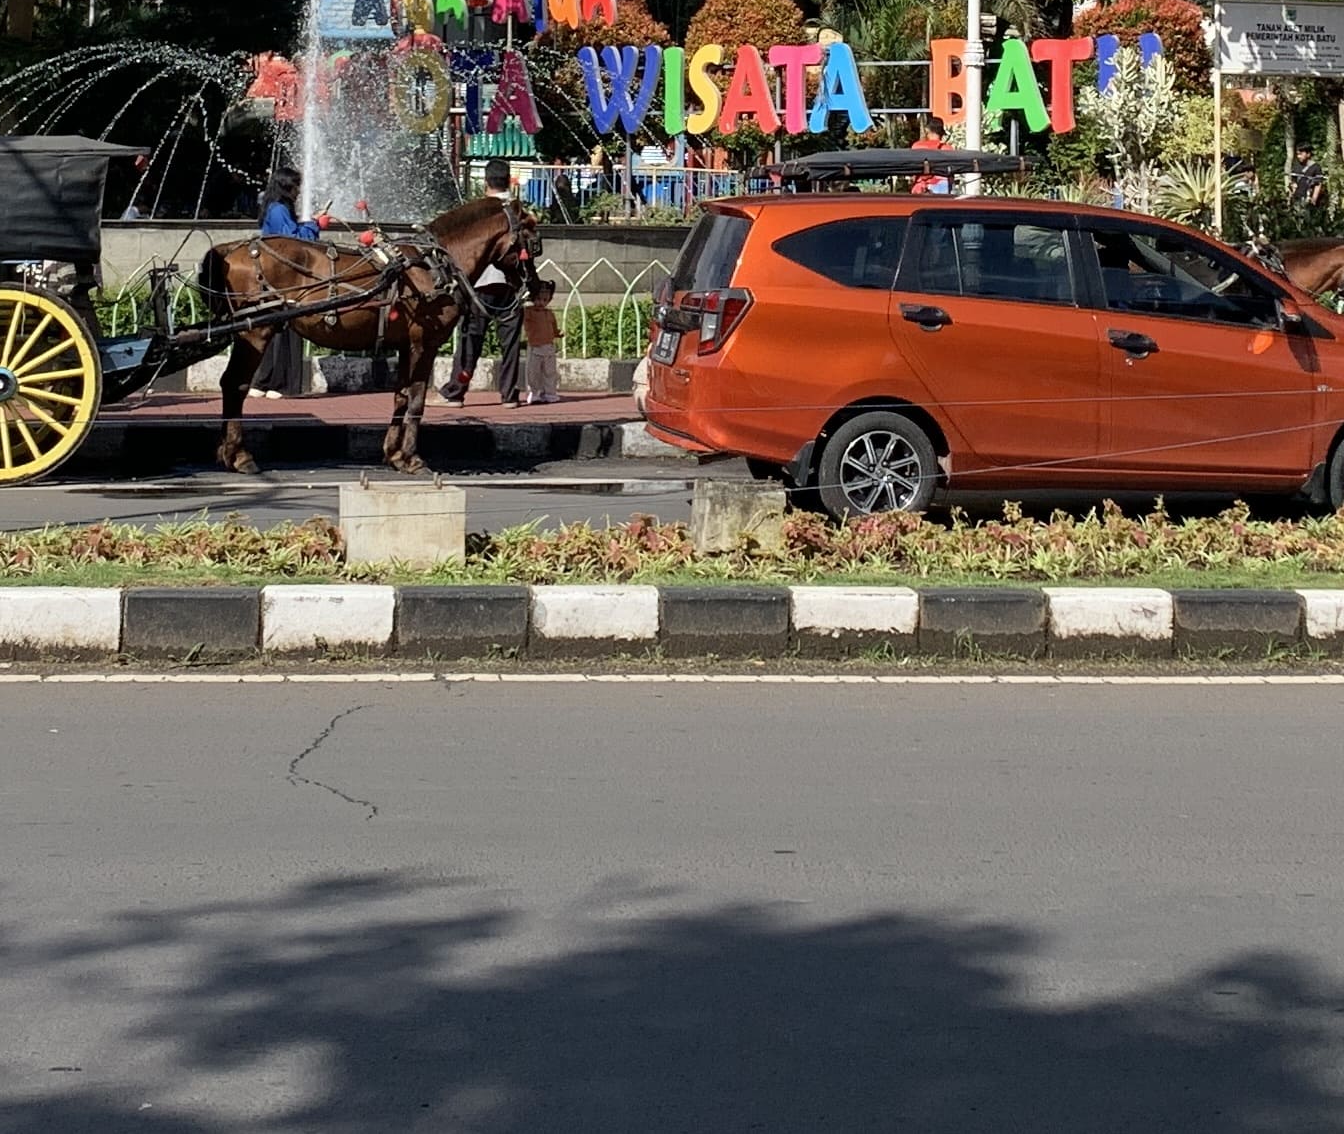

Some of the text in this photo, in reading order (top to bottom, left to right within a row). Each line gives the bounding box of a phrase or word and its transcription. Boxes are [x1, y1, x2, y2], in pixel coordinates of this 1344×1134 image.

[1304, 24, 1326, 34] MILIK
[1294, 33, 1316, 43] KOTA
[1316, 34, 1336, 43] BATU
[577, 40, 876, 134] WISATA
